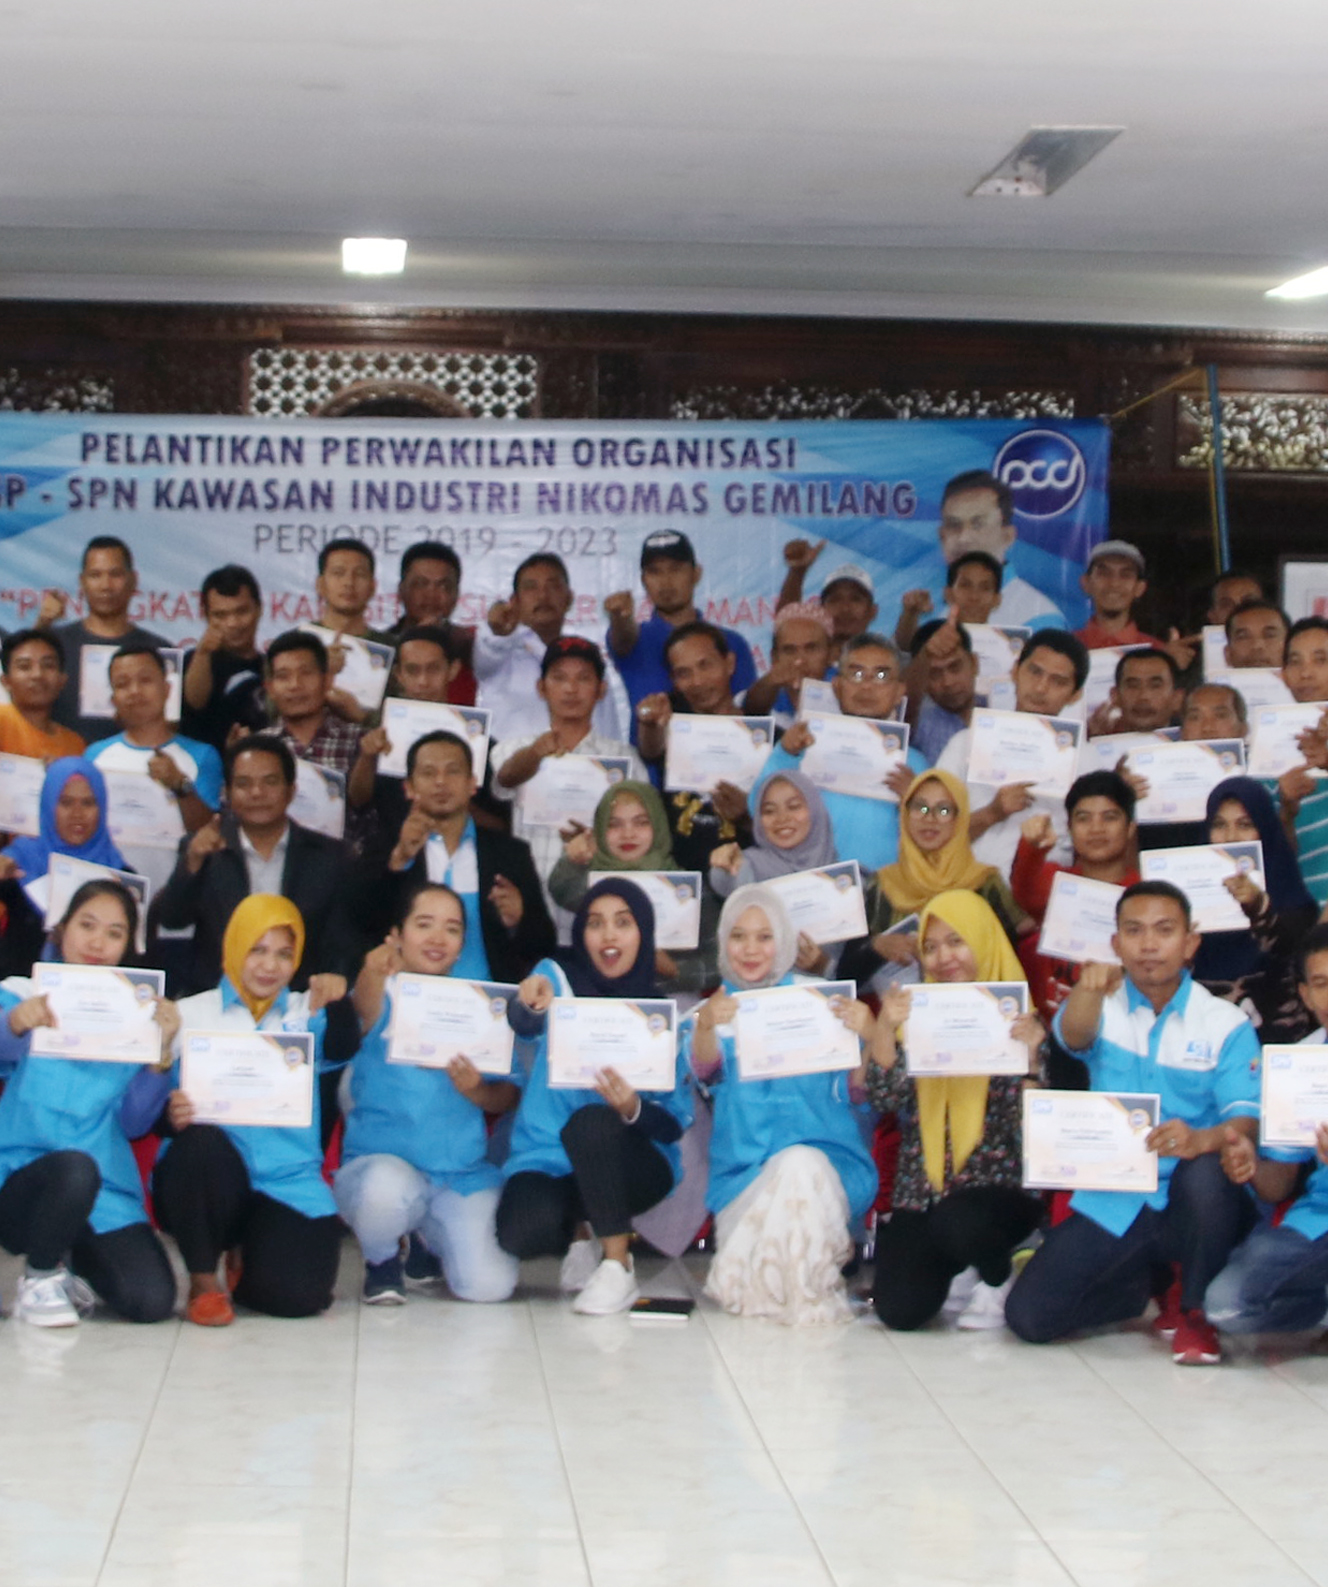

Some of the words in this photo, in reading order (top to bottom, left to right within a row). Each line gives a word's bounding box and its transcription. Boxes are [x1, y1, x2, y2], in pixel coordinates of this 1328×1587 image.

[81, 432, 304, 466] PELANTIKAN
[322, 437, 556, 468] PERWAKILAN
[572, 437, 796, 468] ORGANISASI
[68, 477, 138, 509] SPN
[154, 478, 334, 511] KAWASAN
[351, 479, 520, 514] INDUSTRI
[538, 482, 708, 515] NIKOMAS
[724, 482, 916, 516] GEMILANG
[255, 524, 400, 556] PERIODE
[537, 526, 617, 556] 2023
